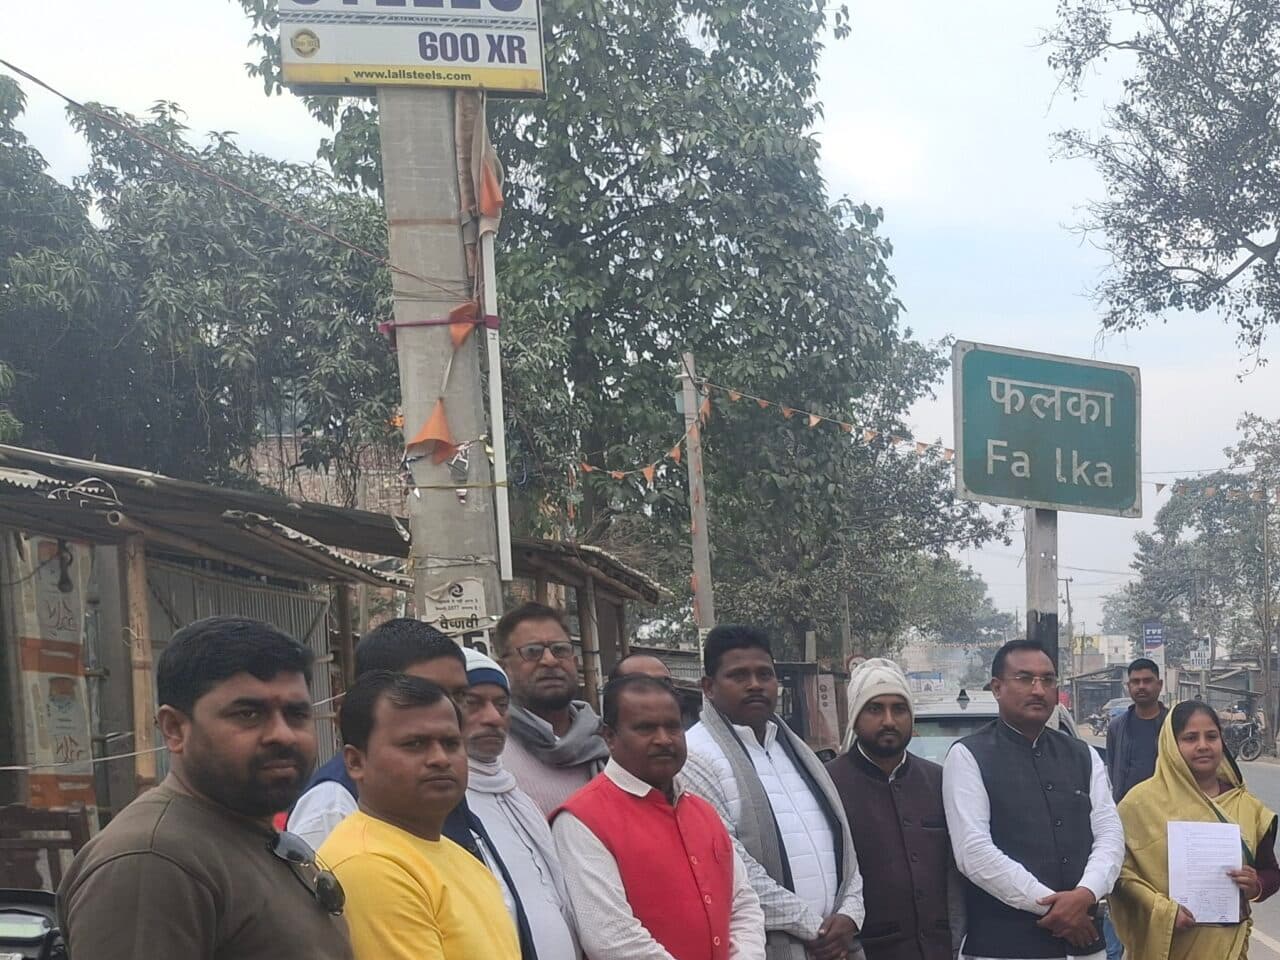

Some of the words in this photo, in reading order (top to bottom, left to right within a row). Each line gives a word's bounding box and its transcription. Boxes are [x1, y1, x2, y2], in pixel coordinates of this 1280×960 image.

[418, 31, 480, 62] 600
[487, 34, 528, 64] XR
[353, 68, 472, 81] www.lallsteels.com
[987, 375, 1115, 427] फलका
